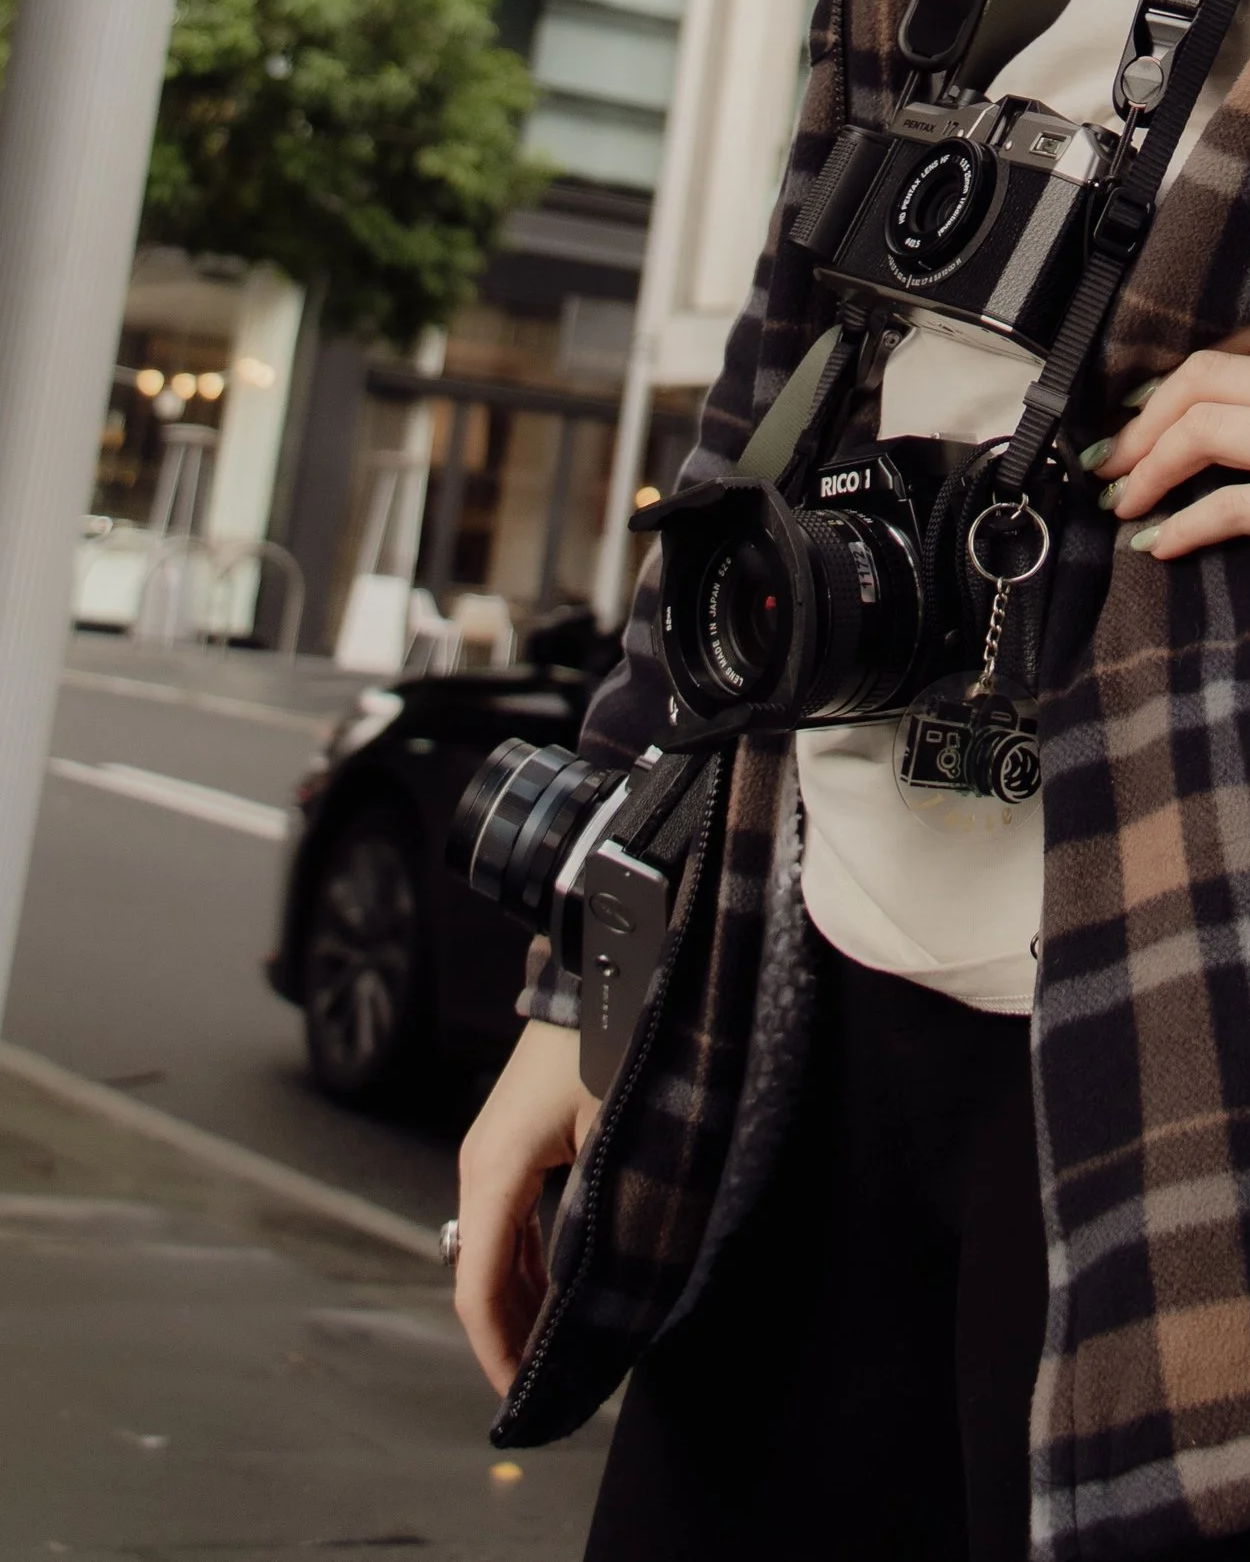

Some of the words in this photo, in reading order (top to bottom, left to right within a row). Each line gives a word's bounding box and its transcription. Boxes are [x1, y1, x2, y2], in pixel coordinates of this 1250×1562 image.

[903, 119, 936, 134] PENTAX
[942, 120, 960, 137] 17
[901, 178, 921, 210] PENTAX
[921, 159, 939, 178] LENS
[709, 582, 721, 617] JAPAN
[709, 622, 717, 636] IN
[712, 639, 727, 668] MADE
[725, 667, 744, 687] LENS
